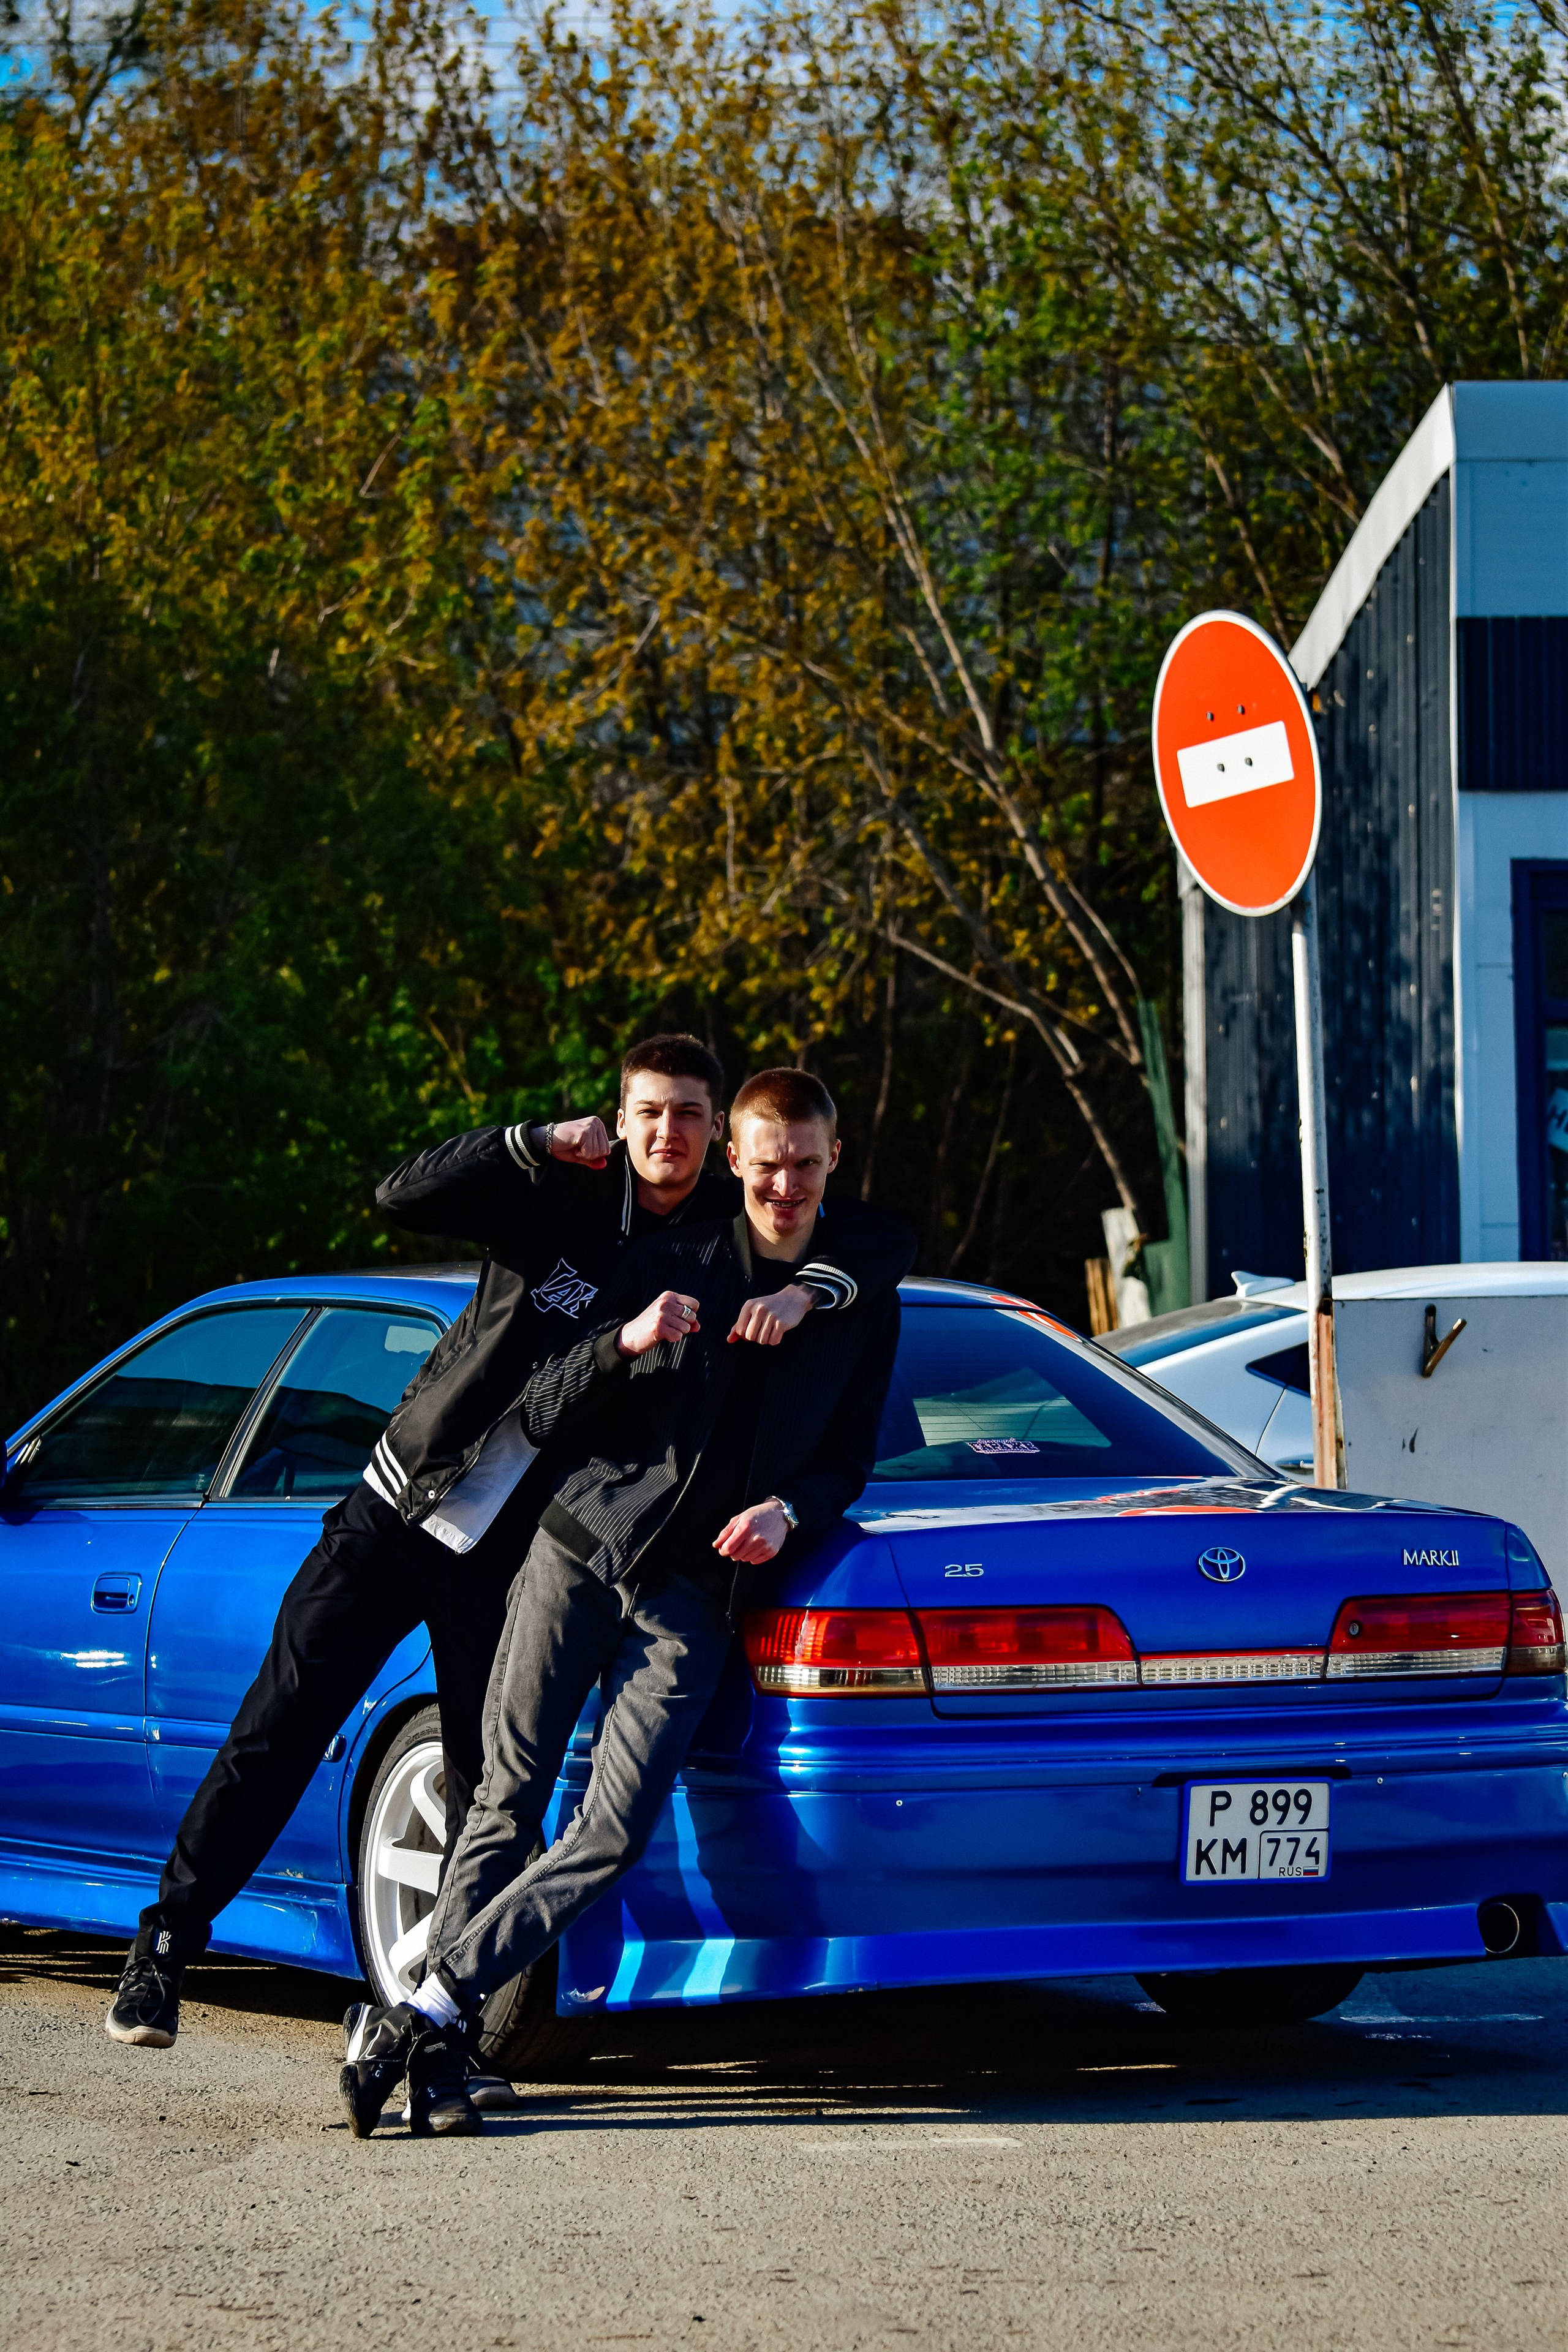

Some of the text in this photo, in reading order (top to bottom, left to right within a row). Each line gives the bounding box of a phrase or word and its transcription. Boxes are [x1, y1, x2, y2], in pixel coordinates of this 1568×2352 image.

[1250, 1789, 1313, 1825] 899
[1267, 1836, 1320, 1866] 774
[1278, 1866, 1302, 1877] RUS
